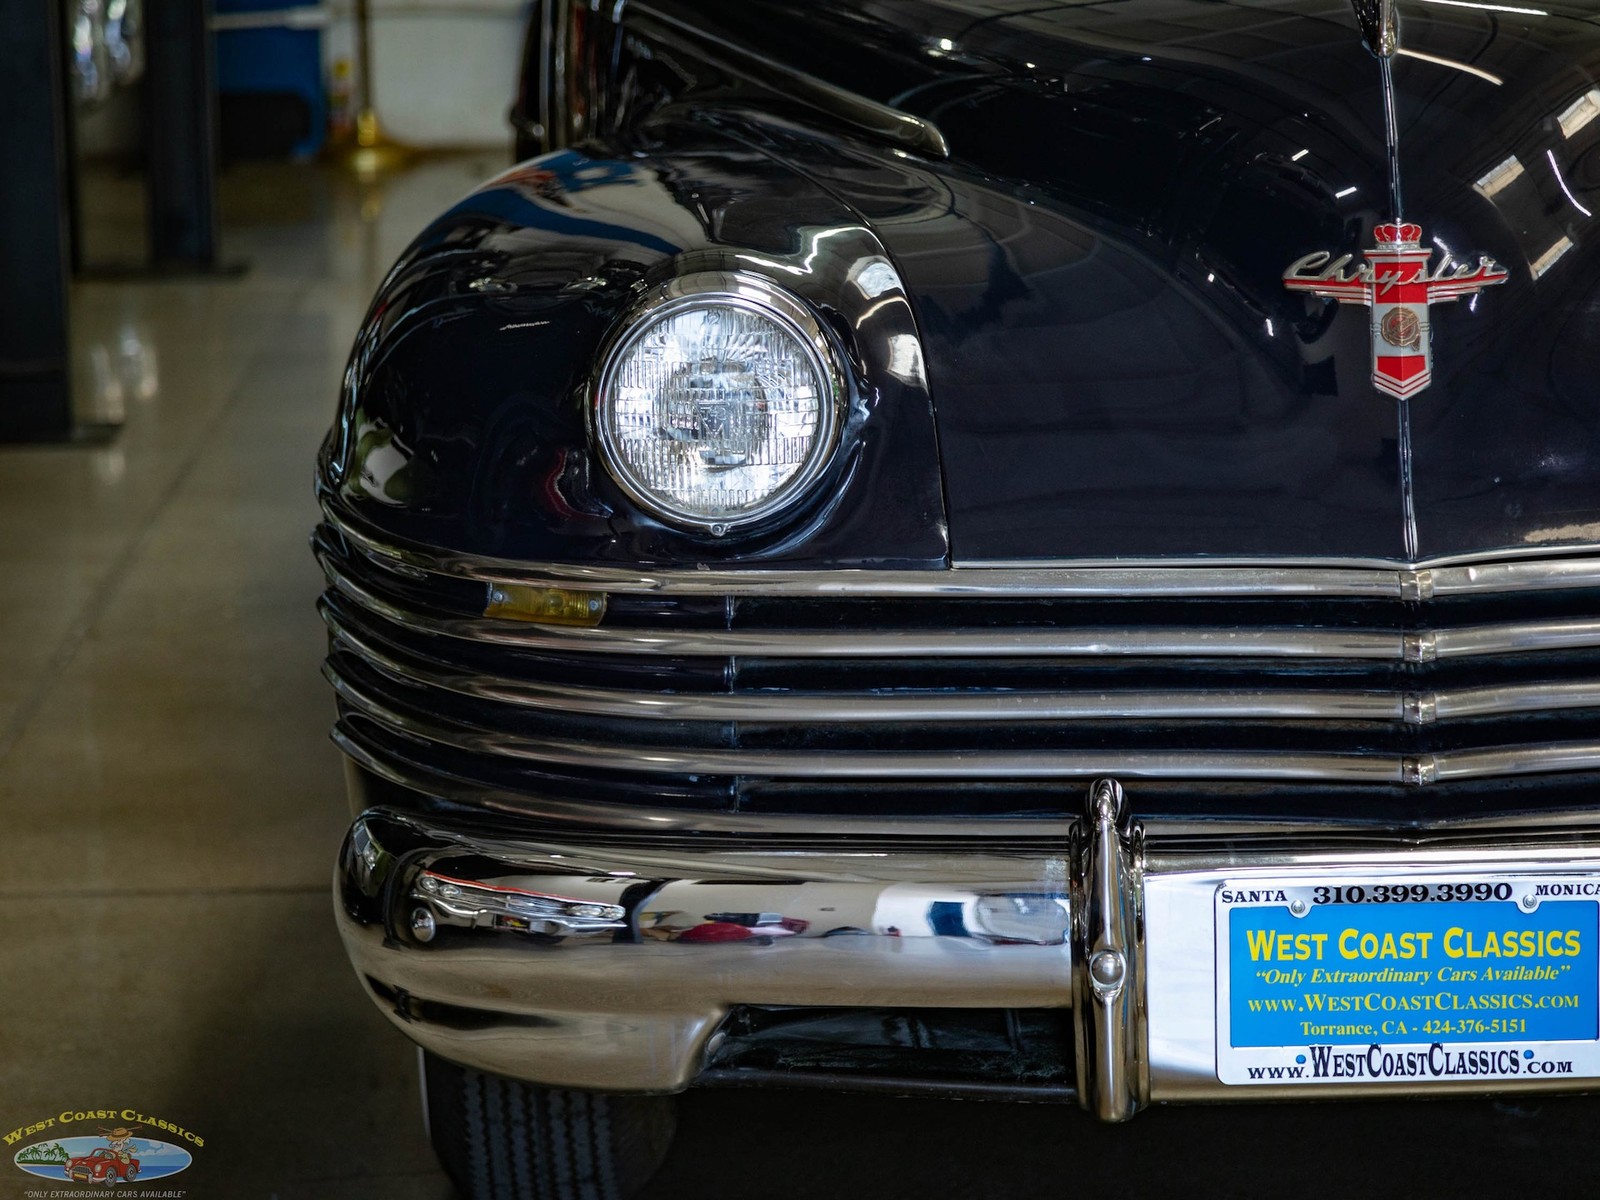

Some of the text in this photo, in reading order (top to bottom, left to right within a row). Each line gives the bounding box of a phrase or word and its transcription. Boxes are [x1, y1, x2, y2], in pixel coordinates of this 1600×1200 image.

[1282, 251, 1508, 295] Chrysler
[1222, 890, 1288, 903] SANTA
[1313, 883, 1513, 904] 310.399.3990
[1246, 927, 1581, 961] WEST COAST CLASSICS
[1311, 967, 1432, 986] Extraordinary
[1437, 966, 1477, 982] Cars
[1300, 1021, 1378, 1037] Torrance,
[1381, 1021, 1408, 1035] CA
[1422, 1019, 1527, 1034] 424-376-5151
